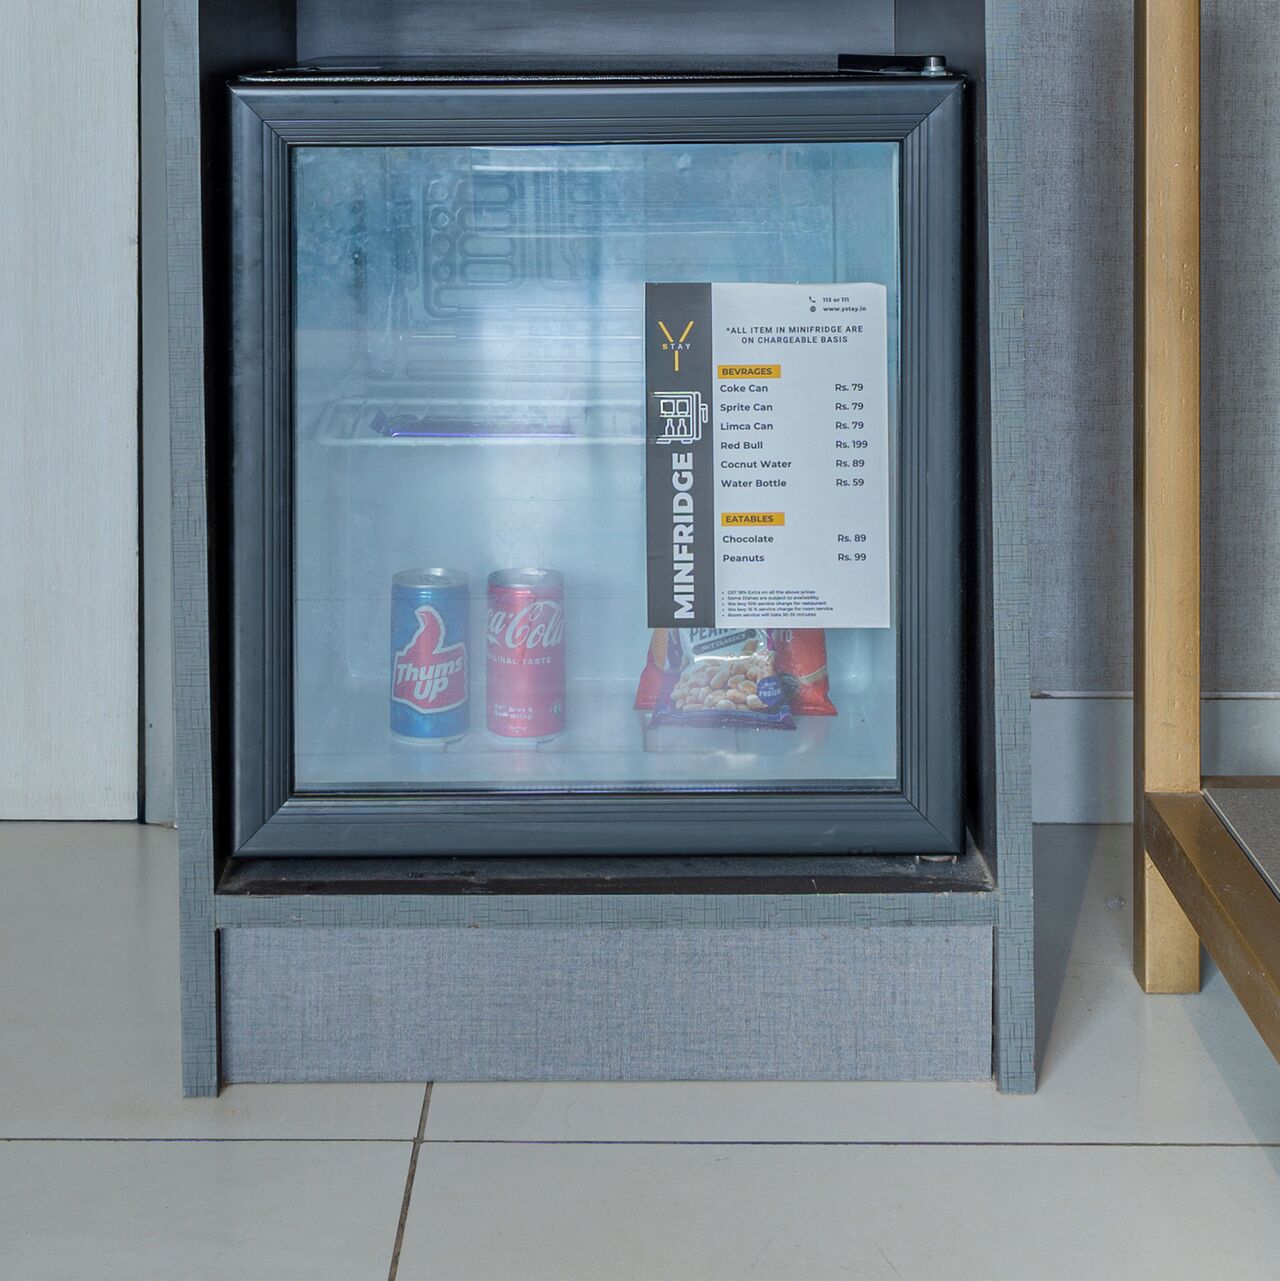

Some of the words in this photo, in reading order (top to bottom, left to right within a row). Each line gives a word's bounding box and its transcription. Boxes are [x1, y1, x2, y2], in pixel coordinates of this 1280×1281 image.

[823, 305, 867, 313] www.ystay.in
[750, 326, 772, 335] ITEM
[775, 326, 786, 334] IN
[788, 325, 843, 334] MINIFRIDGE
[845, 325, 864, 333] ARE
[741, 336, 755, 345] ON
[757, 335, 818, 344] CHARGEABLE
[820, 335, 848, 344] BASIS
[722, 367, 773, 376] BEVRAGES
[720, 384, 746, 393] Coke
[748, 384, 769, 393] Can
[835, 383, 849, 392] Rs.
[851, 383, 864, 392] 79
[720, 403, 751, 413] Sprite
[753, 403, 773, 412] Can
[835, 402, 849, 411] Rs.
[851, 402, 864, 411] 79
[720, 422, 751, 431] Limca
[754, 422, 774, 431] Can
[835, 421, 850, 430] Rs.
[852, 421, 864, 430] 79
[721, 441, 740, 450] Red
[743, 441, 763, 450] Bull
[835, 440, 850, 449] Rs.
[852, 440, 869, 449] 199
[721, 460, 757, 469] Cocnut
[760, 460, 792, 469] Water
[836, 459, 850, 468] Rs.
[852, 459, 865, 468] 89
[721, 479, 753, 488] Water
[756, 479, 787, 488] Bottle
[836, 478, 850, 487] Rs.
[852, 478, 865, 487] 59
[725, 514, 774, 523] EATABLES
[673, 452, 695, 619] MINFRIDGE
[722, 535, 774, 544] Chocolate
[837, 534, 852, 543] Rs.
[854, 534, 867, 543] 89
[723, 554, 765, 563] Peanuts
[837, 553, 852, 562] Rs.
[854, 553, 867, 562] 99
[522, 656, 552, 665] TASTE
[395, 655, 464, 685] Thums
